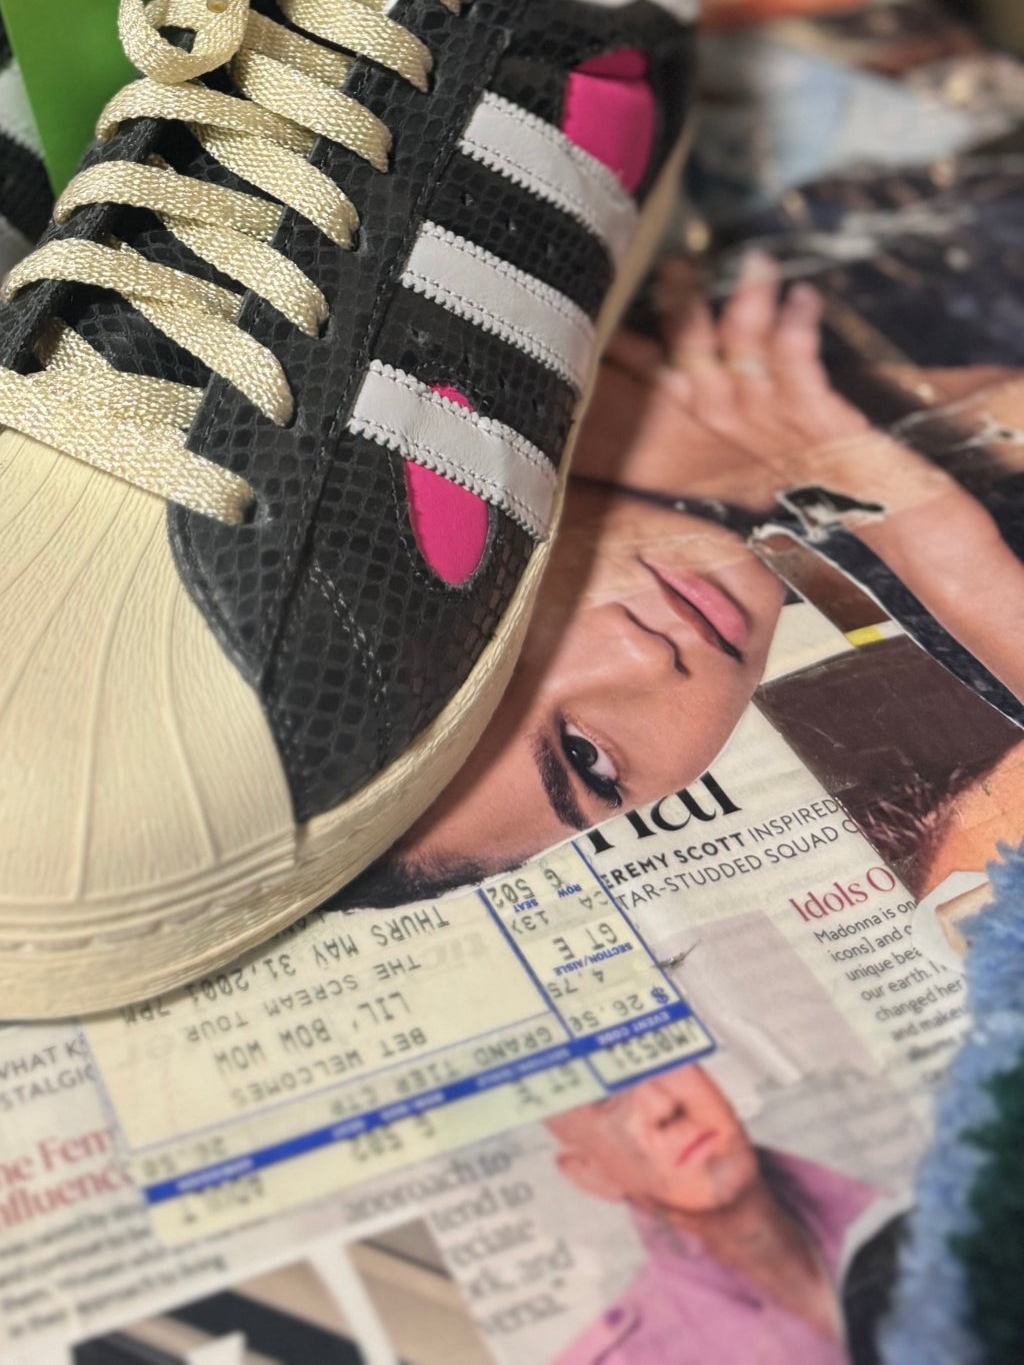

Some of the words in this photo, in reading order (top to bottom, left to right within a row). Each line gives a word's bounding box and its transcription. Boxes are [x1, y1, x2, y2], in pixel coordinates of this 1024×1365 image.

[673, 833, 746, 864] SCOTT
[747, 798, 839, 842] INSPIRED
[763, 826, 839, 864] SQUAD
[513, 898, 539, 914] SEAT
[557, 884, 583, 899] ROW
[788, 882, 869, 922] Idols
[371, 905, 451, 948] THURS
[585, 922, 618, 951] GT
[814, 914, 882, 944] Madonna
[881, 907, 896, 921] is
[875, 926, 904, 948] and
[312, 933, 360, 969] MAY
[552, 936, 576, 961] E
[552, 942, 634, 976] SECTION/AISLE
[186, 953, 297, 1006] 31,2001
[376, 955, 422, 981] THE
[845, 958, 894, 983] unique
[119, 997, 171, 1027] 7PM
[264, 974, 360, 1018] SCREAM
[860, 987, 887, 1002] our
[875, 993, 938, 1023] changed
[937, 978, 963, 997] her
[186, 1012, 249, 1043] TOUR
[280, 1017, 333, 1055] BOW
[380, 1027, 427, 1058] BET
[213, 1038, 267, 1077] WOW
[474, 1026, 554, 1068] GRAND
[230, 1049, 364, 1109] WELCOMES
